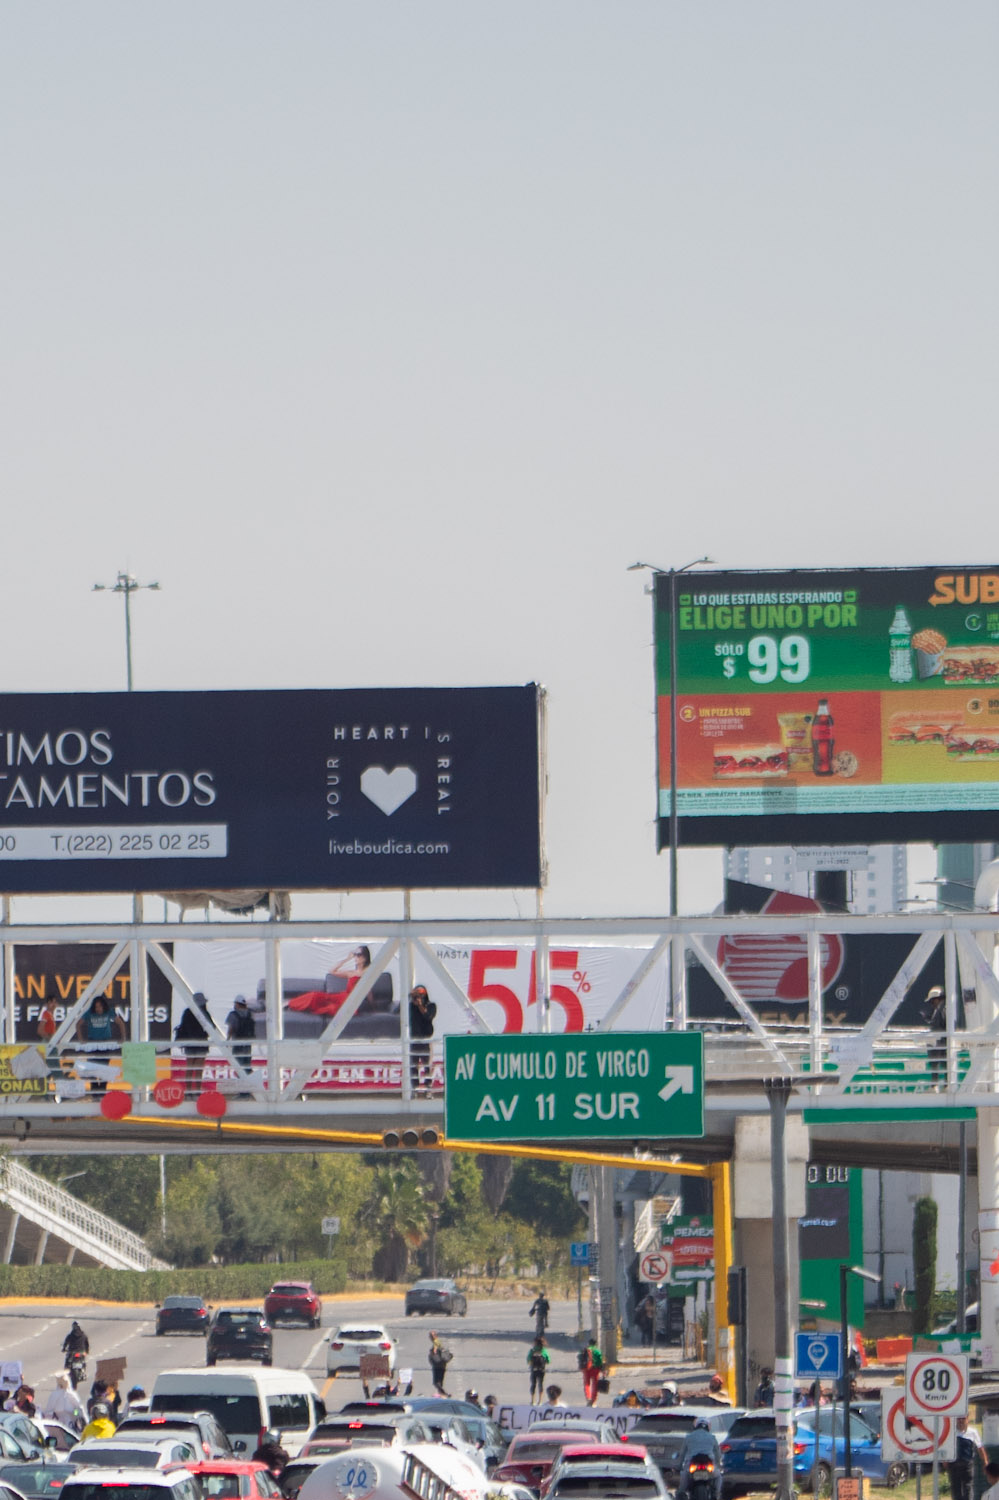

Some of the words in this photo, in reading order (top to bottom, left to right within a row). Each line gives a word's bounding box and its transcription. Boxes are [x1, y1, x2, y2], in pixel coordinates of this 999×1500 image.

[693, 593, 707, 606] LO
[708, 593, 730, 606] QUE
[731, 592, 778, 605] ESTABAS
[779, 591, 843, 604] ESPERANDO
[679, 606, 746, 630] ELIGE
[751, 604, 804, 629] UNO
[807, 603, 858, 628] POR
[715, 641, 744, 656] SÓLO
[723, 657, 735, 680] $
[748, 635, 811, 684] 99
[327, 757, 340, 820] YOUR
[334, 726, 410, 741] HEART
[437, 758, 451, 815] REAL
[119, 832, 154, 853] 225
[159, 832, 182, 852] 02
[186, 831, 210, 852] 25
[328, 839, 450, 856] liveboudica.com
[437, 949, 469, 960] HASTA
[56, 974, 149, 999] VENT
[454, 1053, 477, 1081] AV
[485, 1050, 557, 1080] CUMULO
[565, 1051, 588, 1078] DE
[595, 1048, 650, 1077] VIRGO
[475, 1095, 521, 1122] AV
[535, 1093, 555, 1121] 11
[572, 1092, 640, 1120] SUR
[674, 1227, 715, 1237] PEMEX
[922, 1368, 950, 1391] 80
